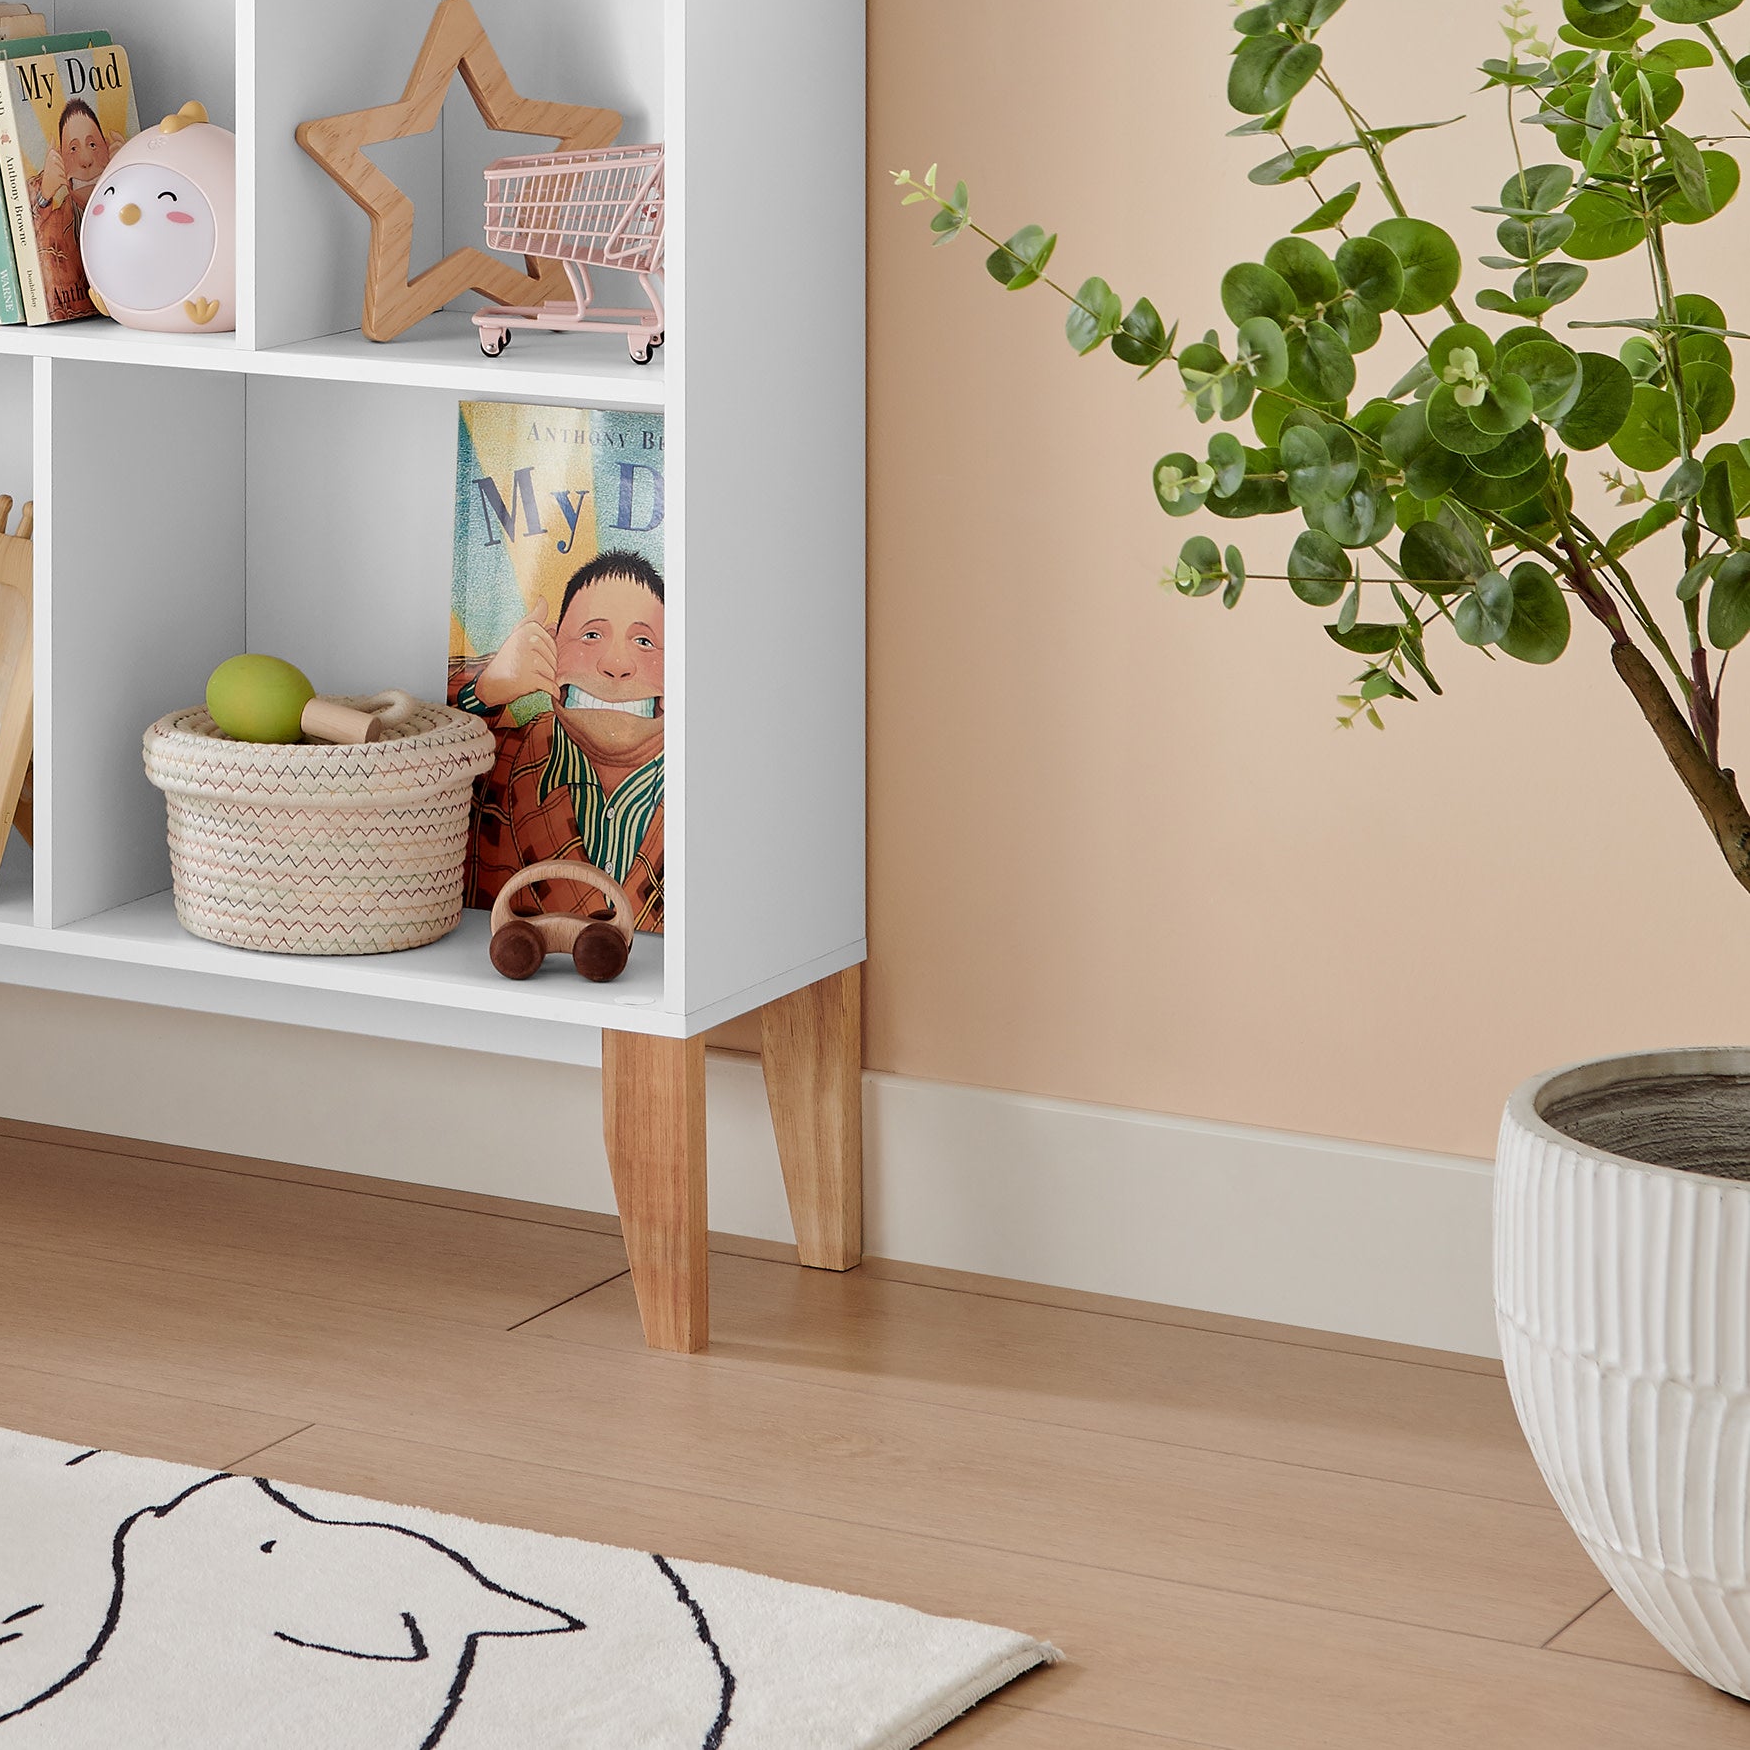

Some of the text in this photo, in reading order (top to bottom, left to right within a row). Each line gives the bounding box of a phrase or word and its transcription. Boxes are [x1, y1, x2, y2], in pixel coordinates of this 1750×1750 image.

[16, 53, 122, 109] My Dad
[5, 155, 27, 246] Anthony Browne
[0, 269, 14, 312] WARNE
[527, 422, 628, 449] ANTHONY
[472, 467, 589, 554] My
